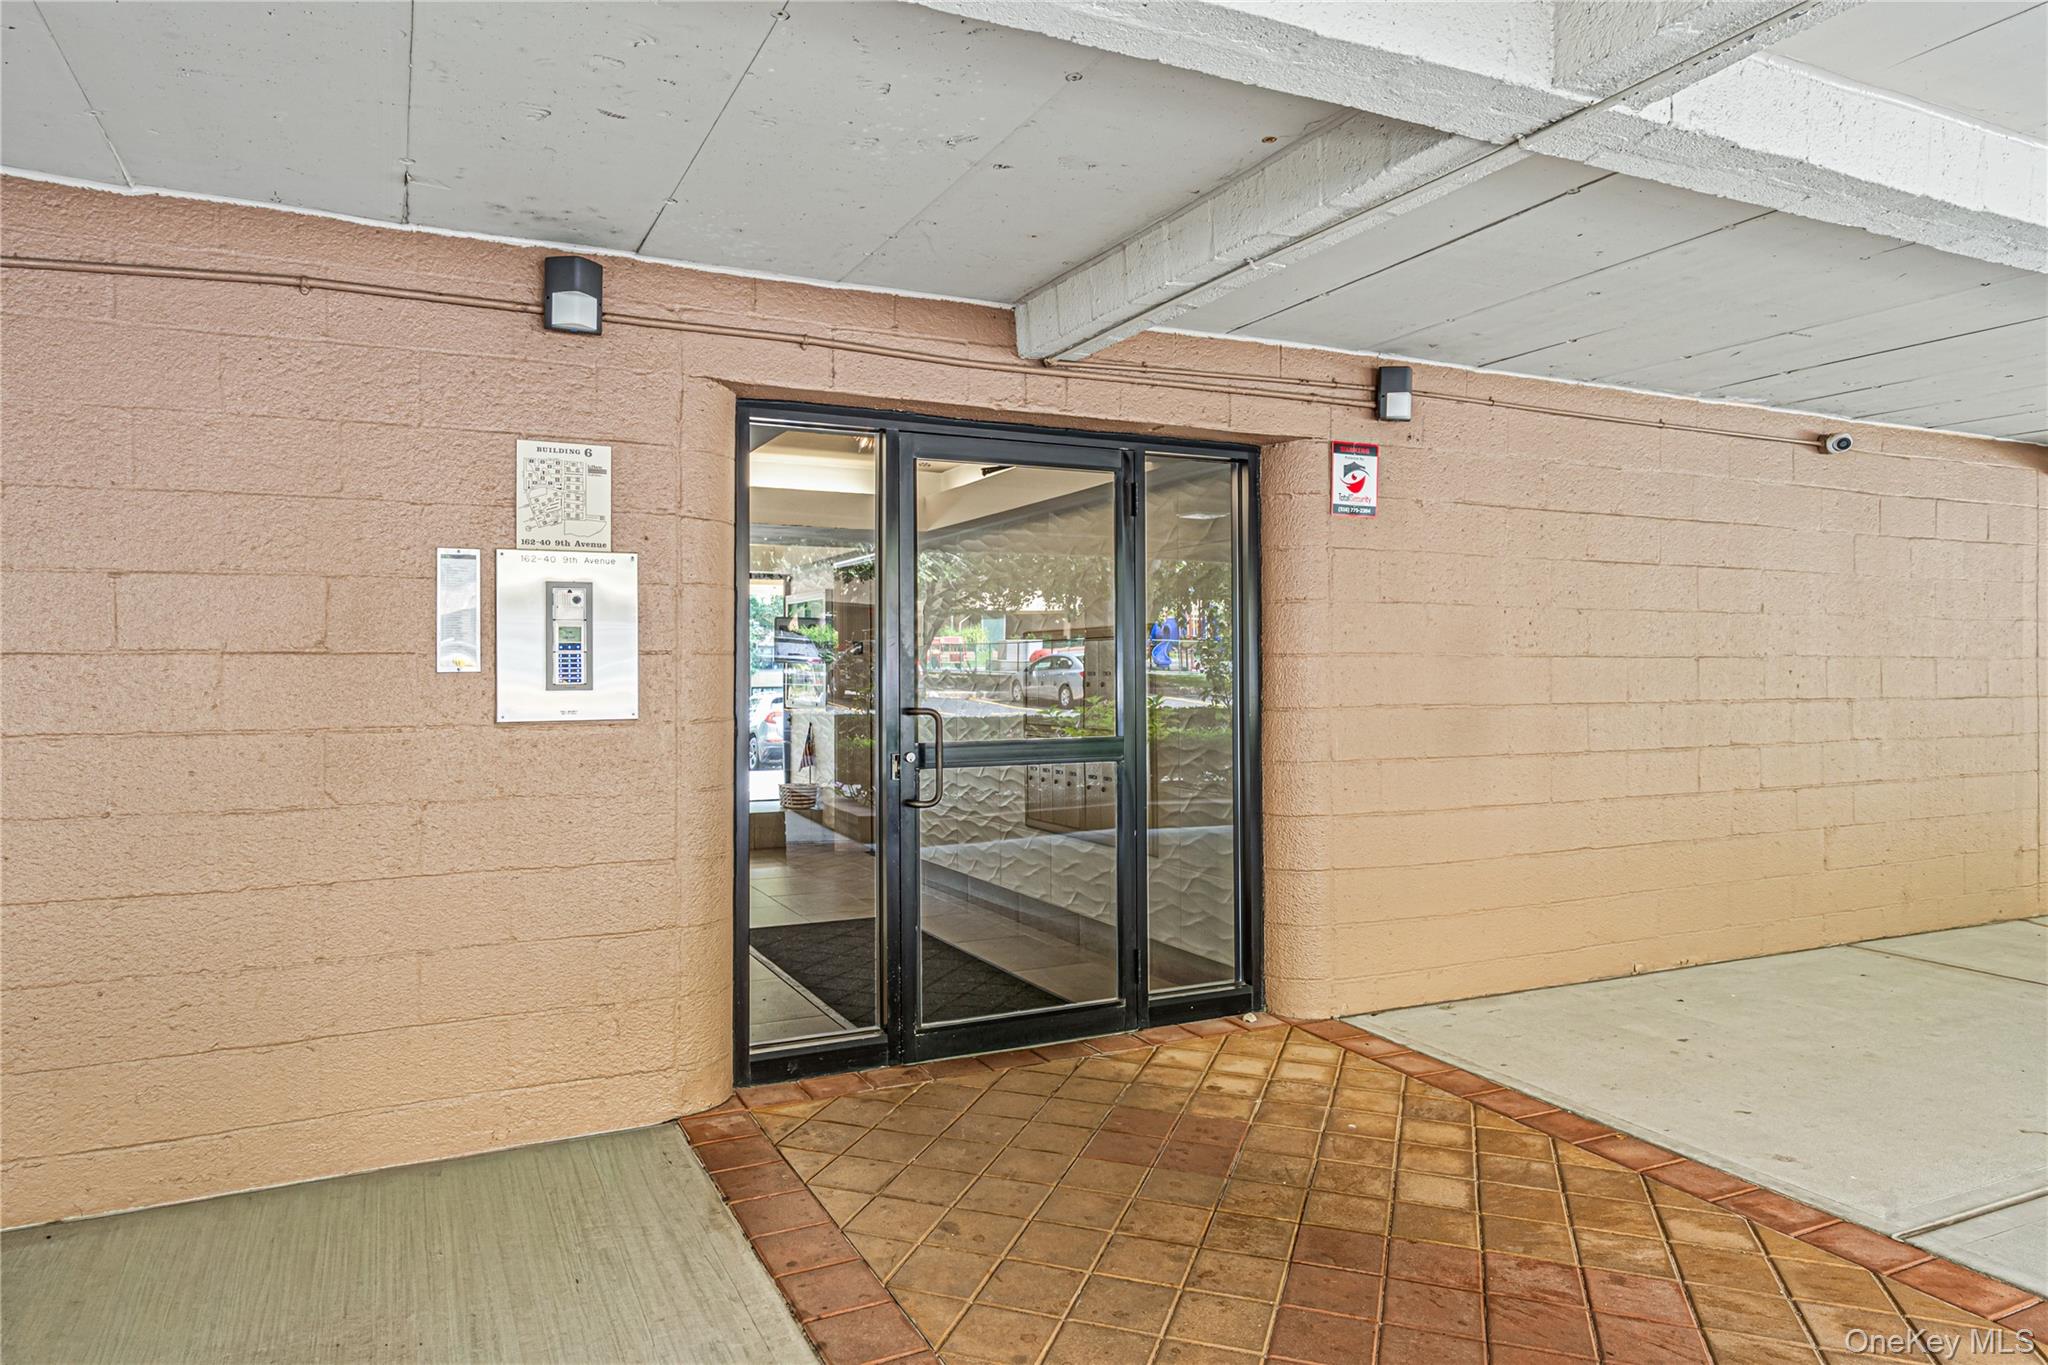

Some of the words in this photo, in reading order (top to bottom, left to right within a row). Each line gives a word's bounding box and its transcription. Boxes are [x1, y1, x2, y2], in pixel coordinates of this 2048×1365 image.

[536, 446, 581, 455] BUILDING
[584, 448, 593, 458] 6
[521, 538, 551, 546] 162-40
[554, 539, 571, 547] 9th
[574, 540, 607, 548] Avenue
[520, 555, 557, 563] 162-40
[562, 556, 578, 564] 9th
[584, 557, 616, 565] Avenue
